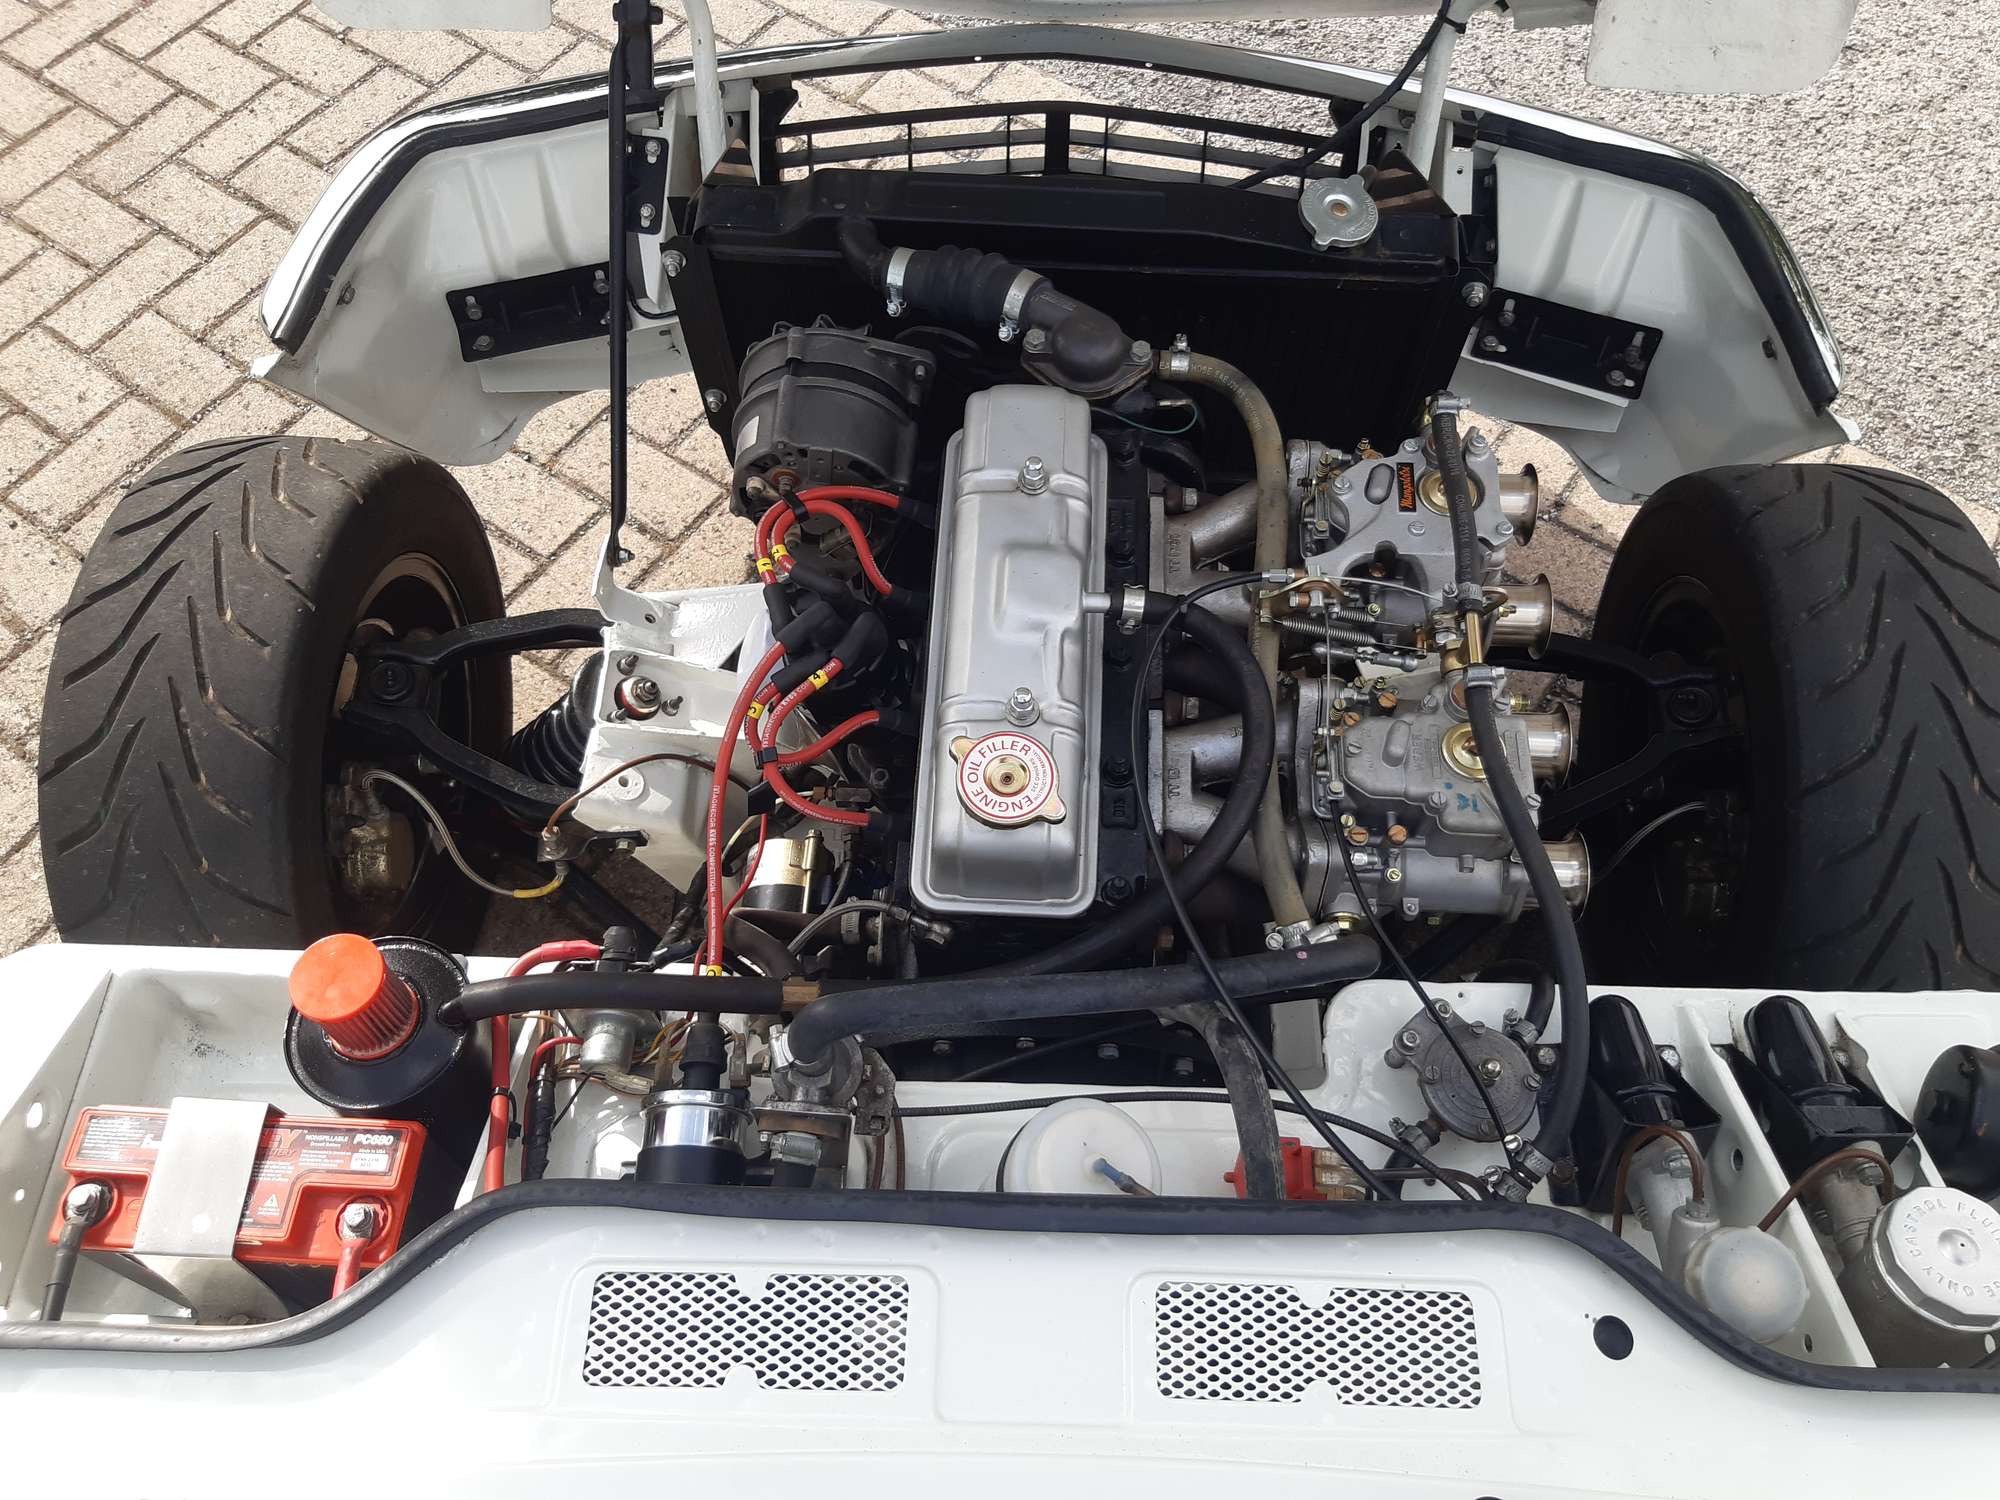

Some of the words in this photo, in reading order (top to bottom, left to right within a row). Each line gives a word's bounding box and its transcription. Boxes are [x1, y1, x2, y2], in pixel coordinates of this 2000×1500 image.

[813, 673, 821, 681] 4
[978, 740, 1031, 759] FILLER
[967, 760, 982, 783] OIL
[971, 787, 1034, 813] ENGINE
[353, 1133, 394, 1146] PC680
[1904, 1199, 1947, 1257] CASTROL
[1957, 1202, 2000, 1242] FLUI
[1922, 1266, 1974, 1298] ONLY
